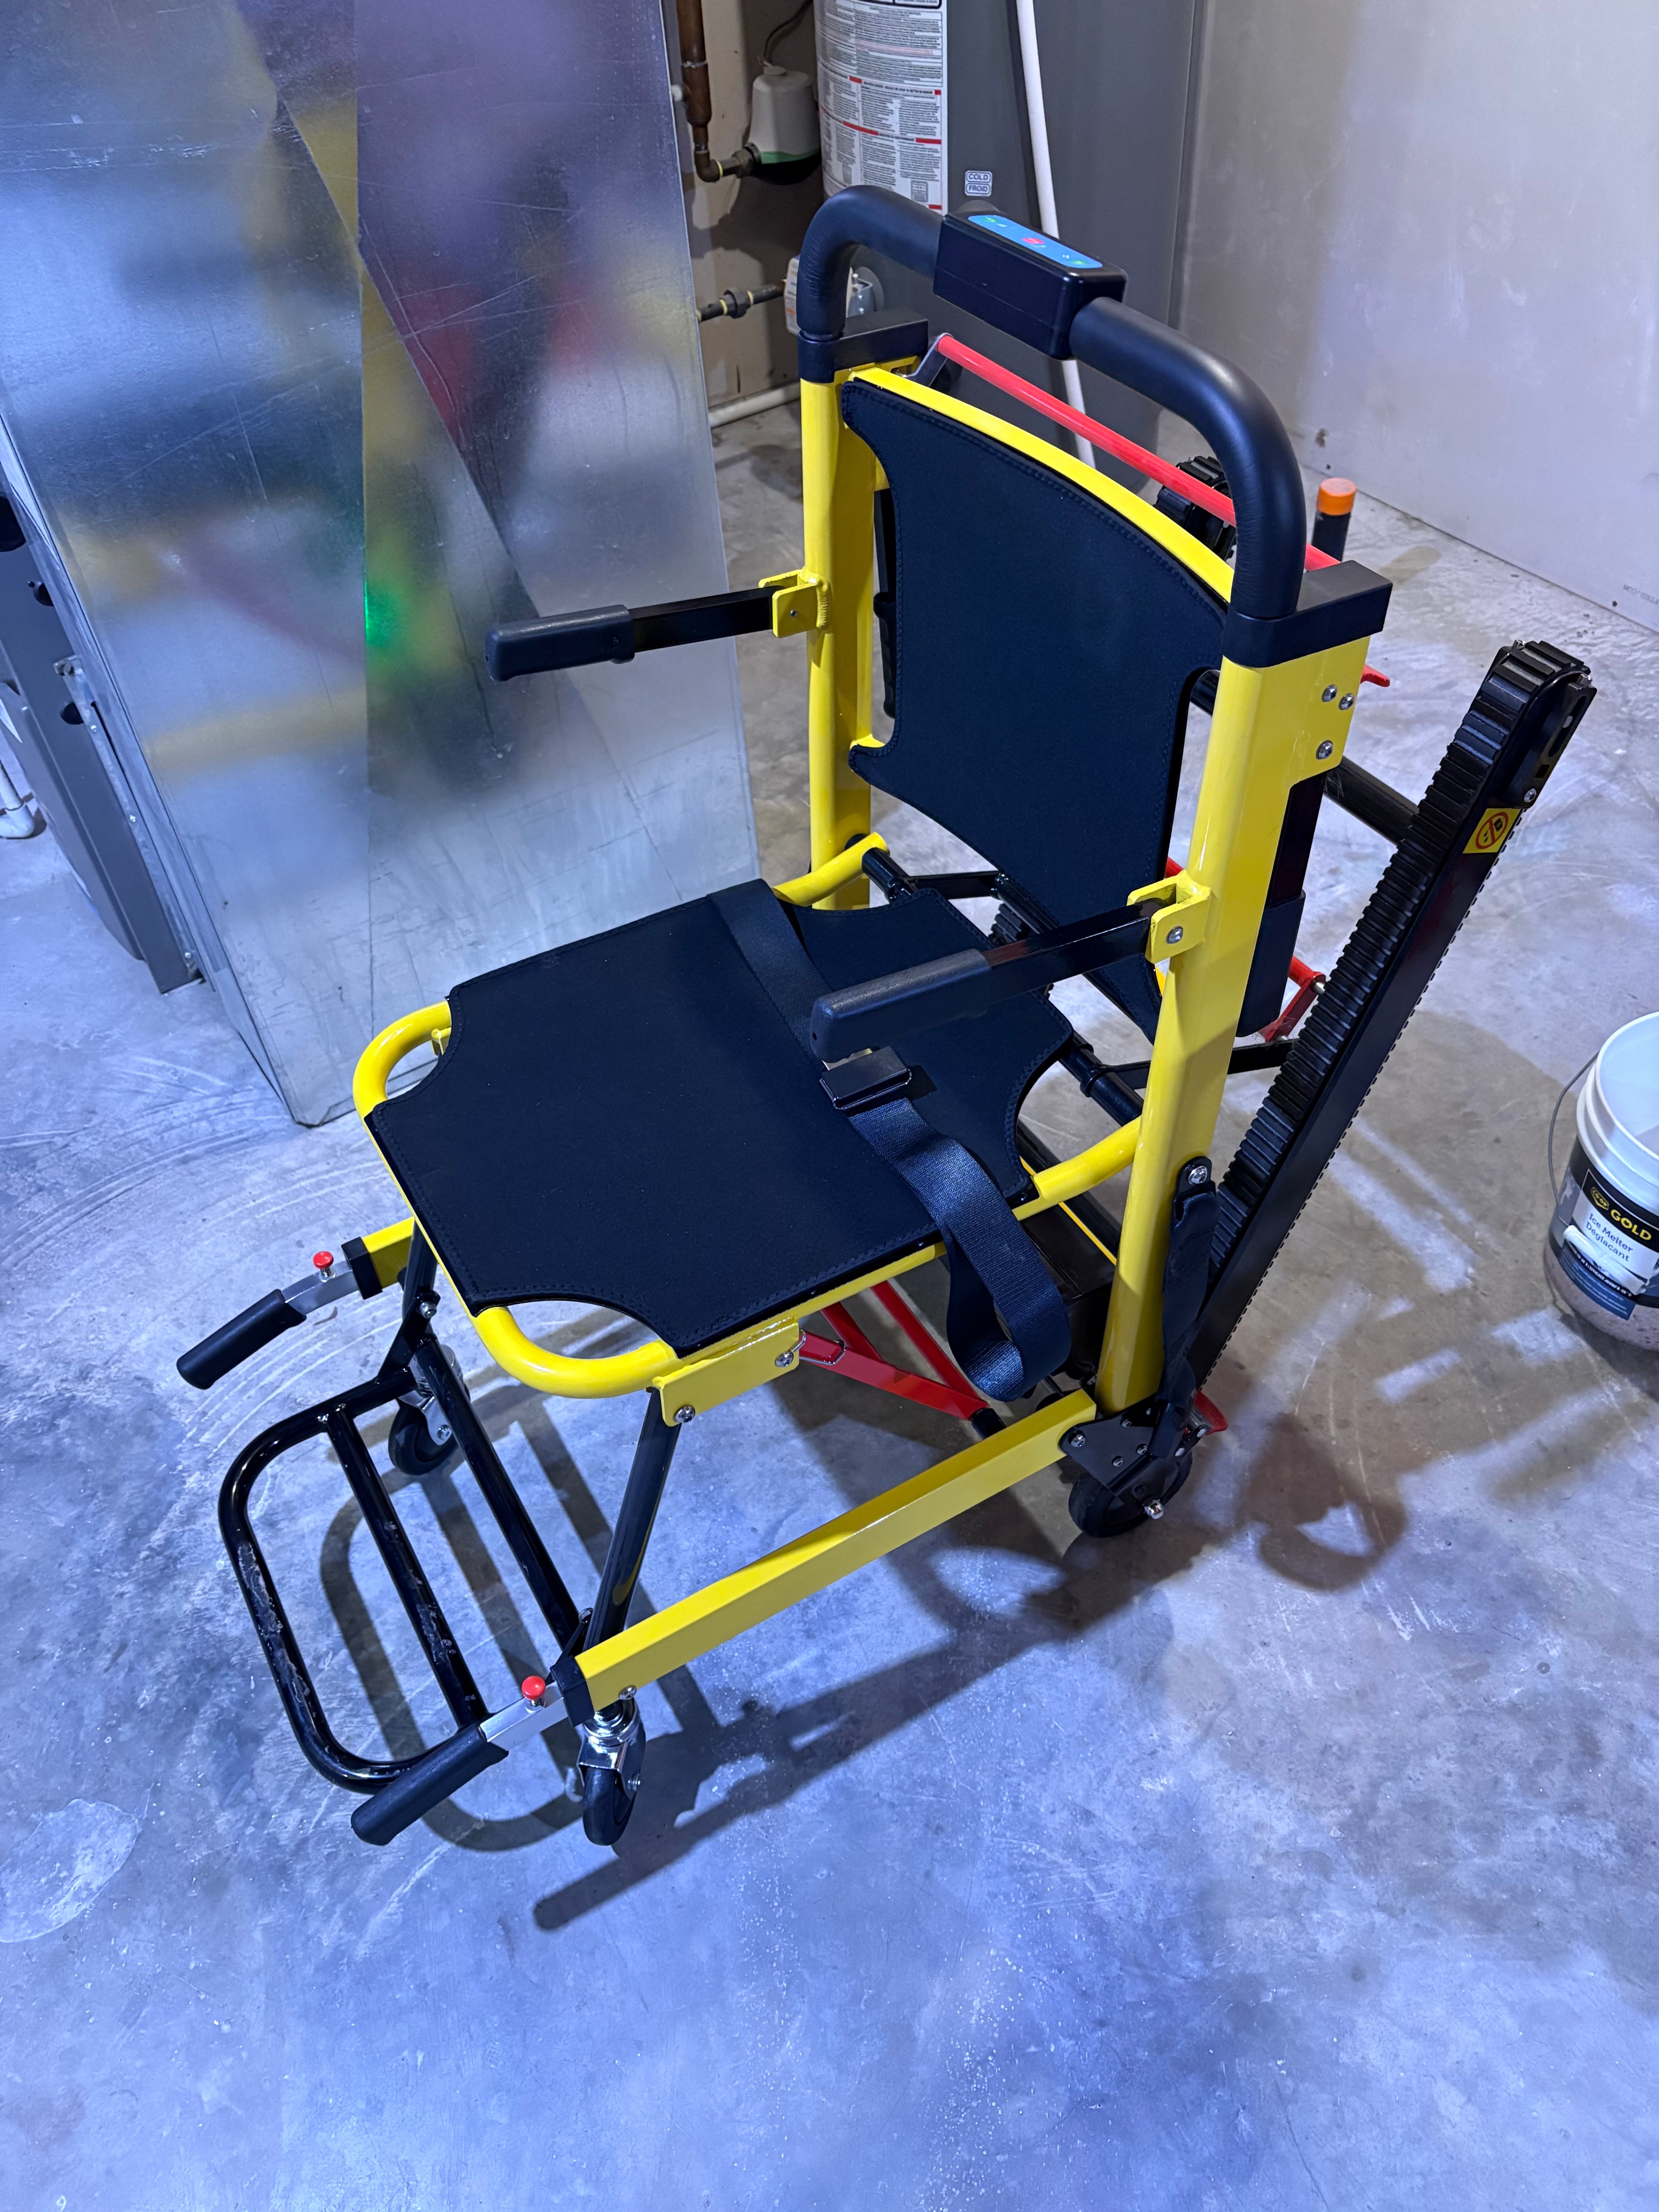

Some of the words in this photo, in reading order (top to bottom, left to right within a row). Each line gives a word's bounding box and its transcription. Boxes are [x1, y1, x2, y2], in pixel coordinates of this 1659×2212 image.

[1593, 1190, 1607, 1206] CO-OP
[1589, 1213, 1601, 1229] Ice
[1602, 1227, 1633, 1252] Melter
[1610, 1209, 1651, 1240] GOLD
